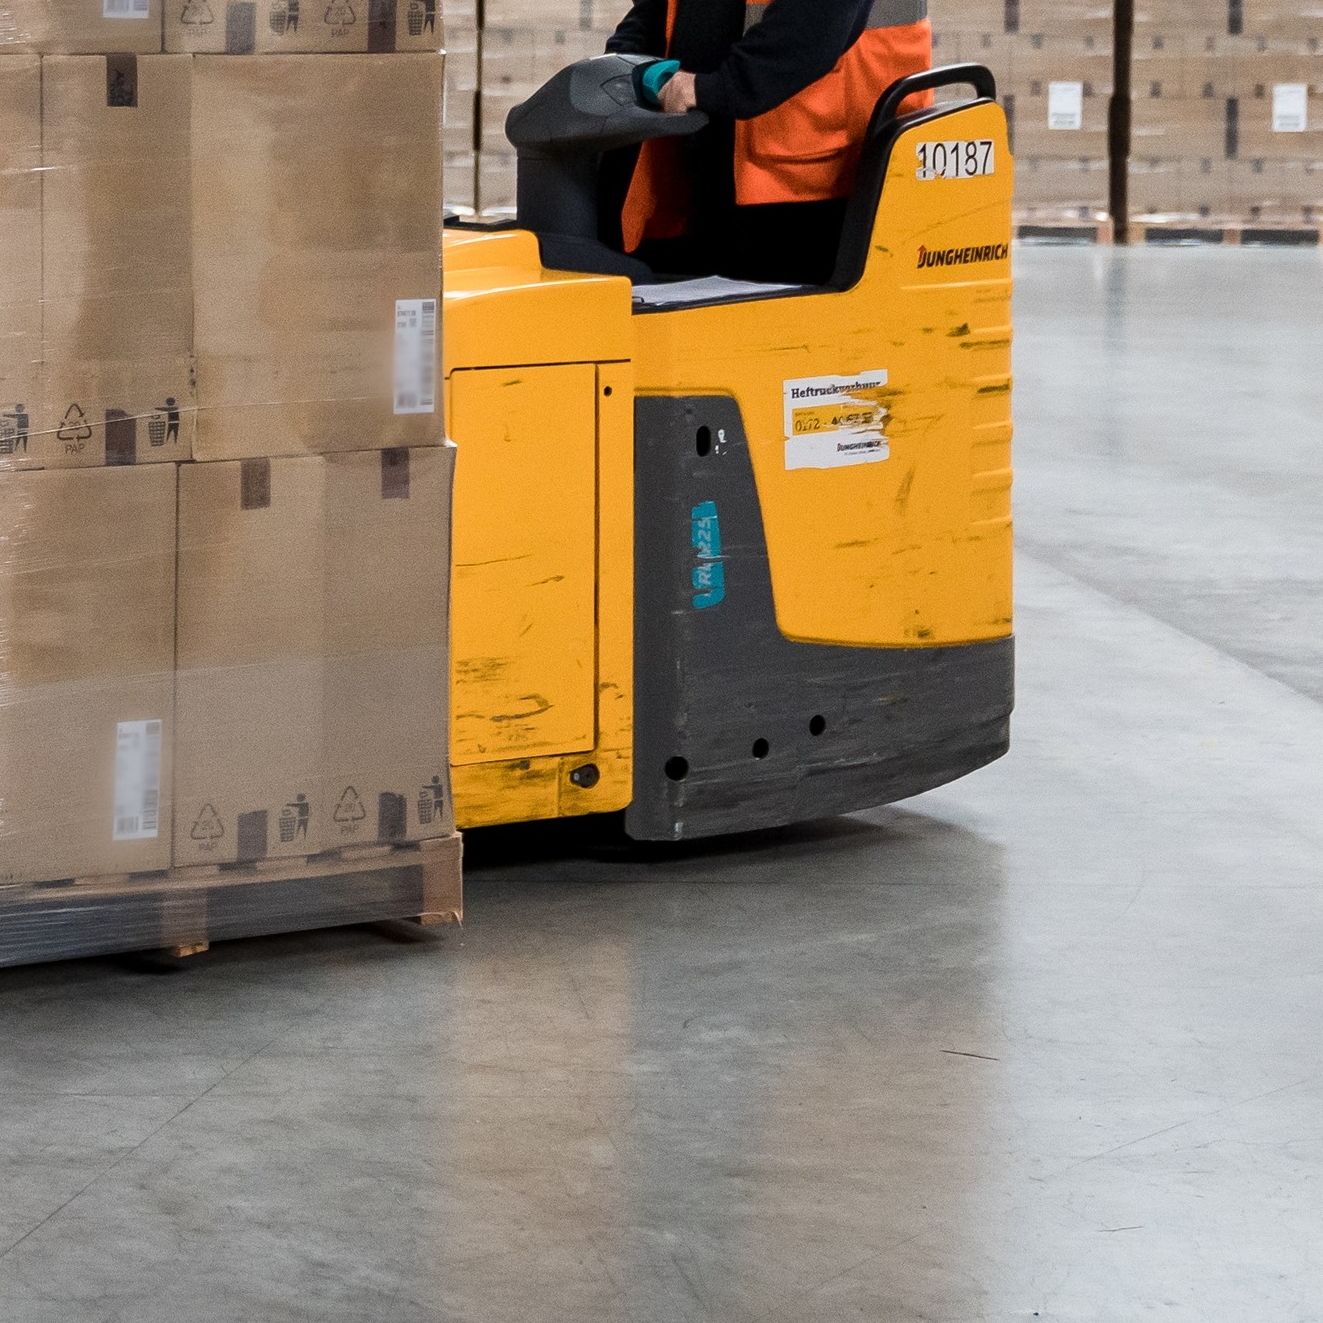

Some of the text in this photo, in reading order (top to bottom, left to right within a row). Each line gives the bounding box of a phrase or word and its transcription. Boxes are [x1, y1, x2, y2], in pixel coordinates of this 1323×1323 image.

[918, 140, 993, 178] 10187
[916, 243, 1009, 269] JUNGHEINRICH
[65, 445, 85, 454] PAP
